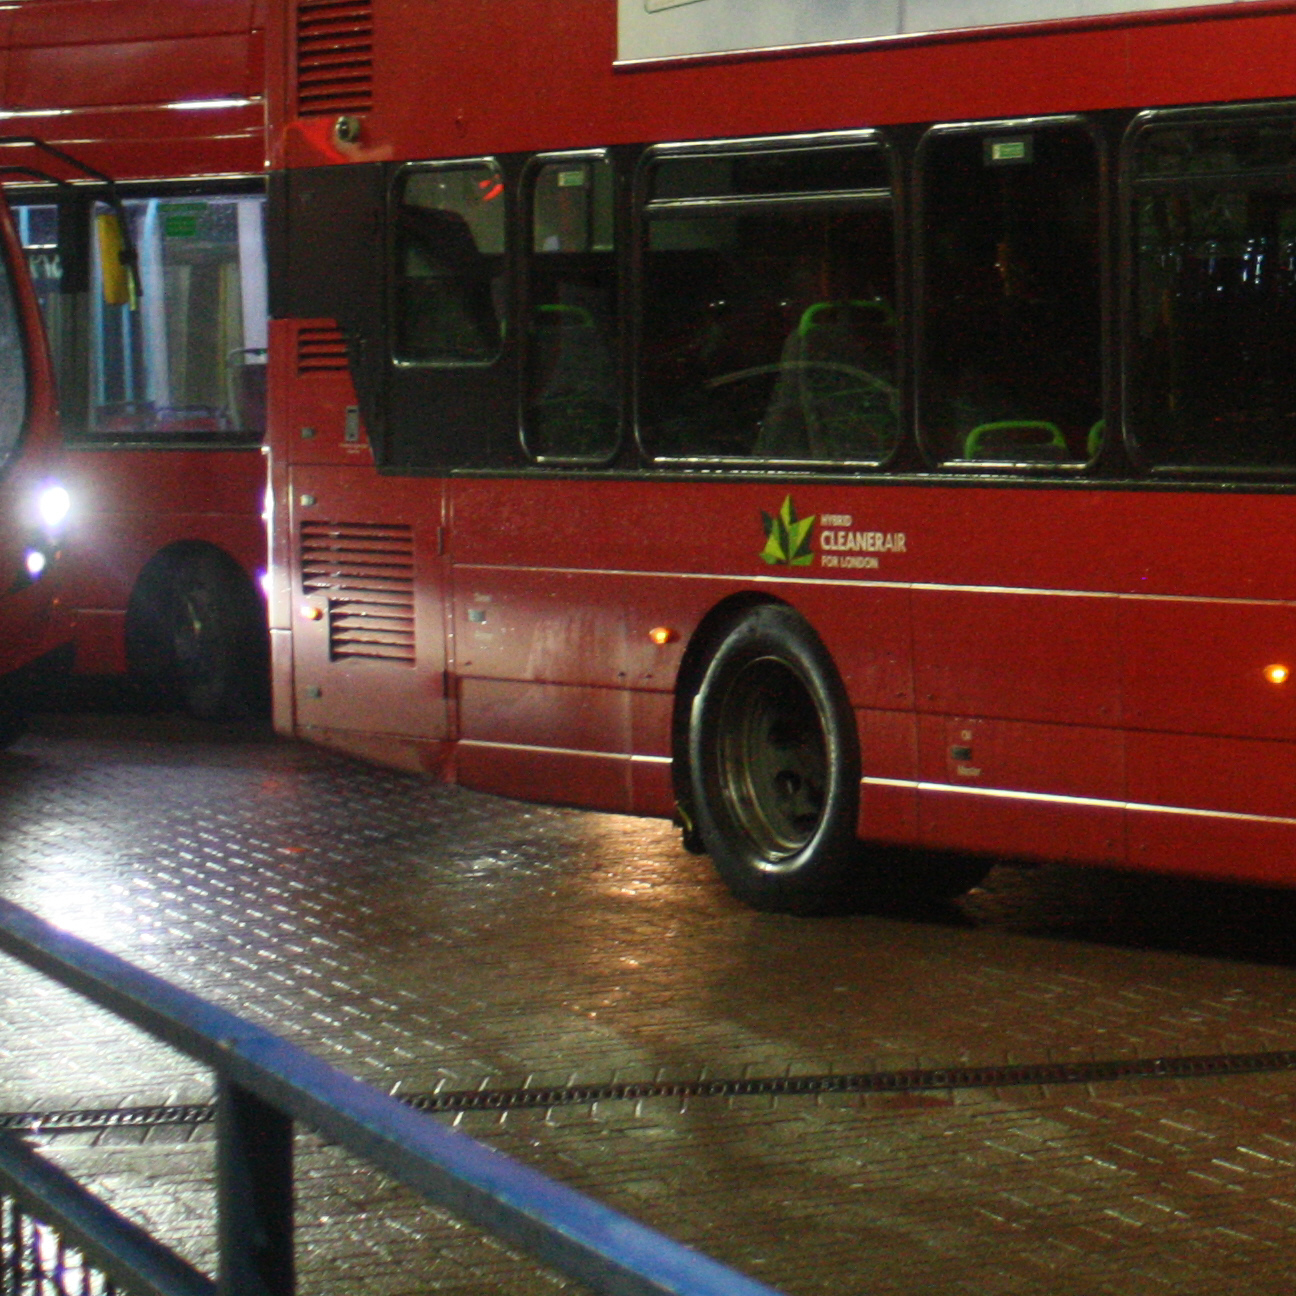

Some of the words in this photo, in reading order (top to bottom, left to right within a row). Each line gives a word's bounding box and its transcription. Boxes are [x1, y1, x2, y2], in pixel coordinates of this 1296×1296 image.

[819, 513, 853, 527] HYBRID
[821, 555, 840, 568] FOR
[840, 556, 880, 569] LONDON
